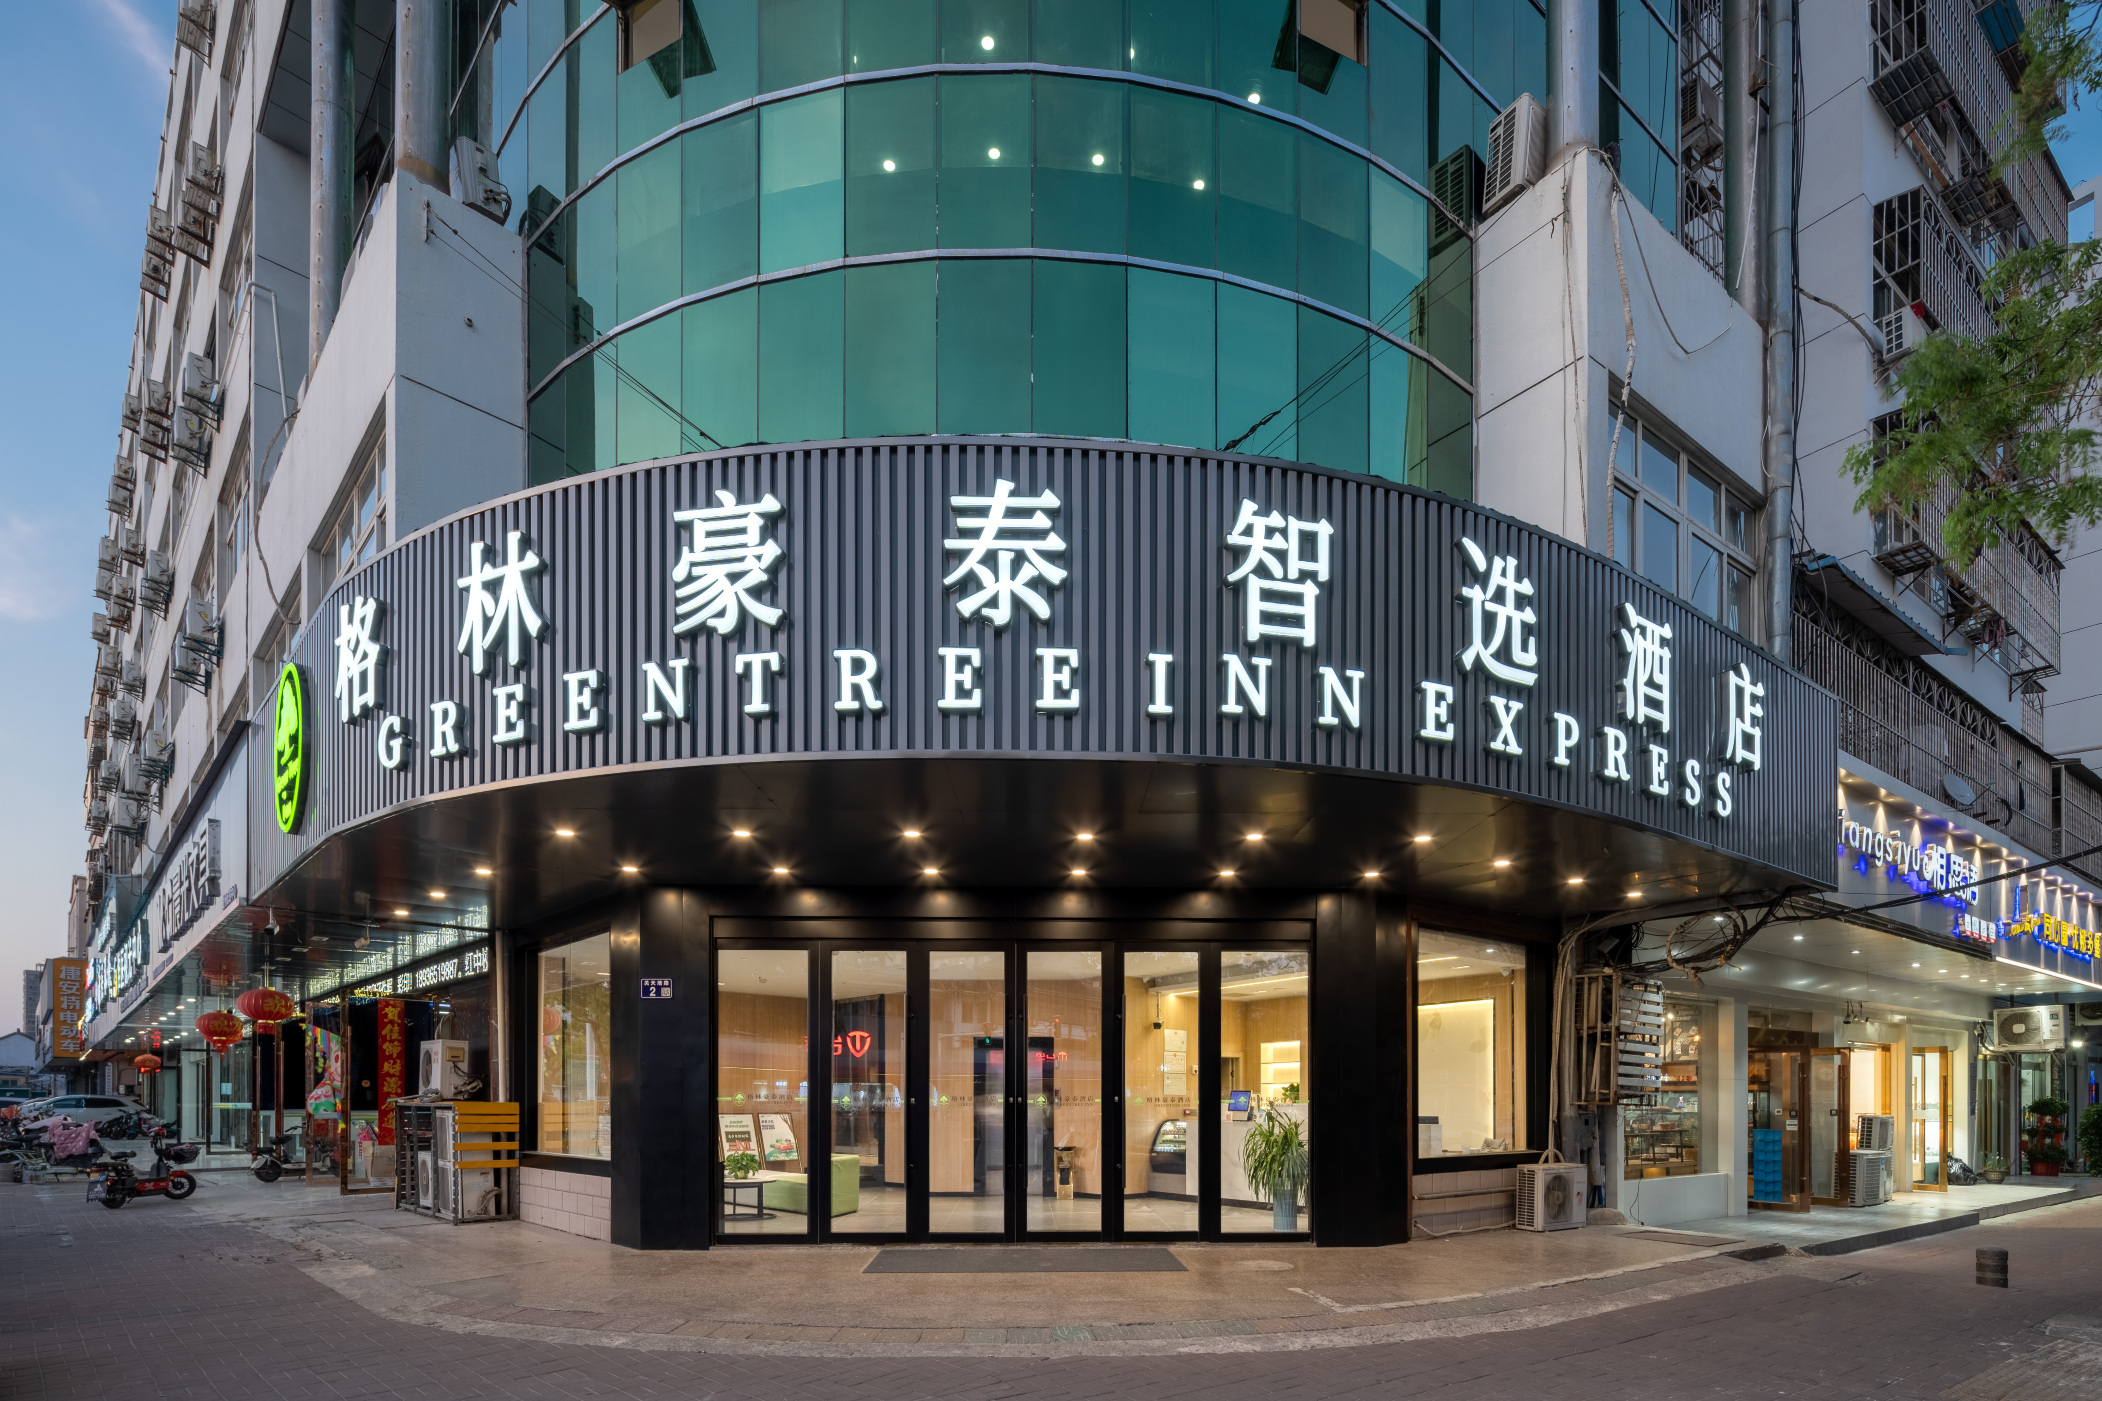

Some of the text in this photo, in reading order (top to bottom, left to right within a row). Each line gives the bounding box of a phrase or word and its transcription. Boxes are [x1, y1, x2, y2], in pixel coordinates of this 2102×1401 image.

[334, 479, 1765, 771] 格林豪泰智选酒店
[378, 646, 1732, 818] GREENTREE INN EXPRESS
[1838, 809, 1921, 876] iangsiyu
[59, 966, 82, 1053] 捷安特电动车
[649, 986, 656, 997] 2
